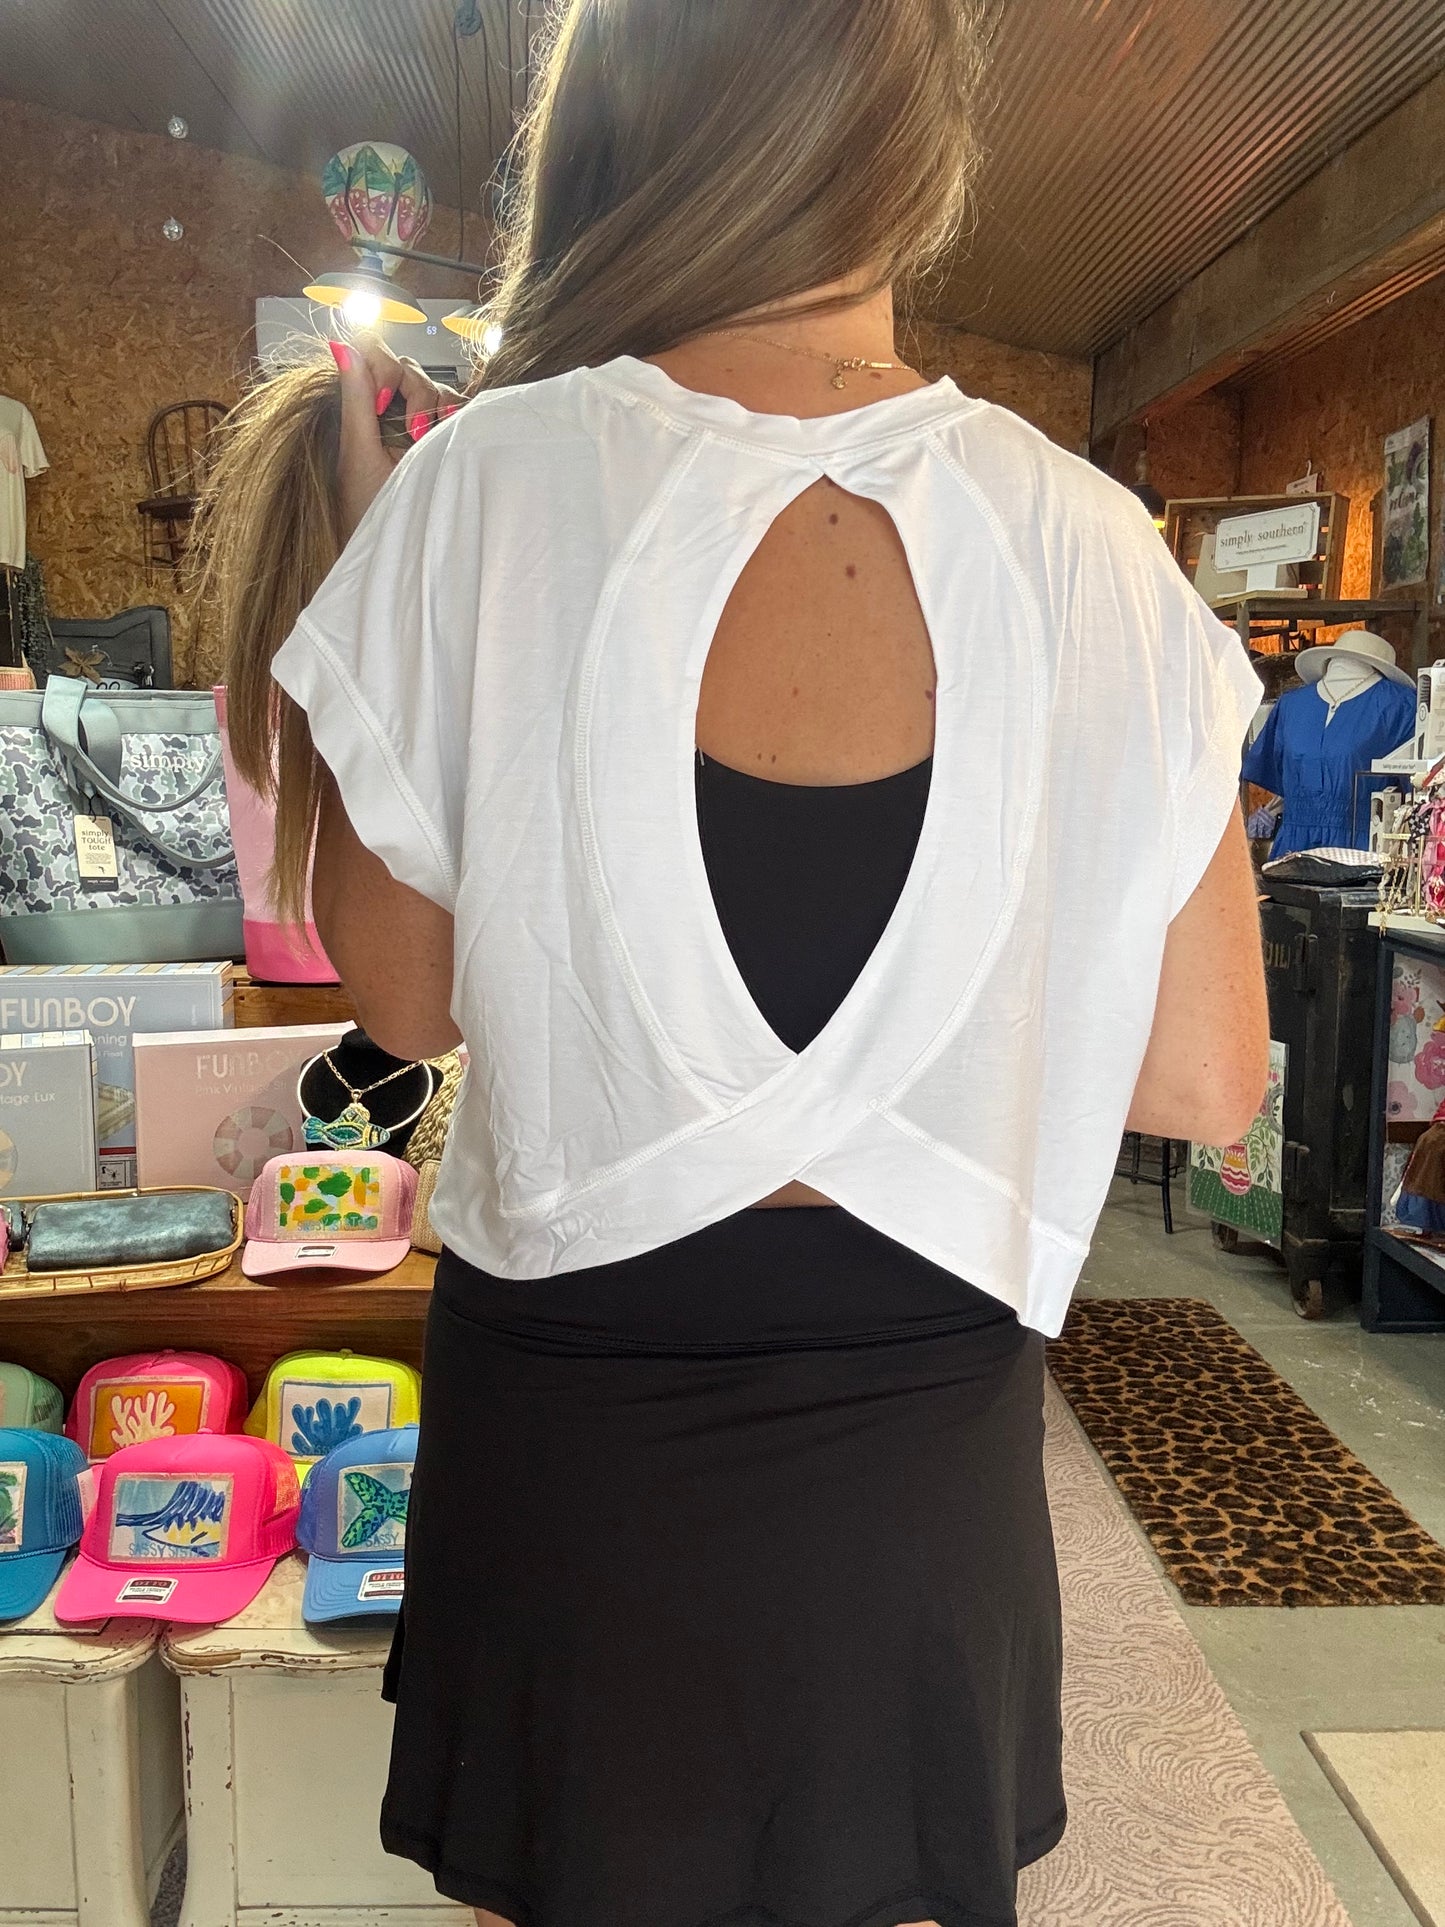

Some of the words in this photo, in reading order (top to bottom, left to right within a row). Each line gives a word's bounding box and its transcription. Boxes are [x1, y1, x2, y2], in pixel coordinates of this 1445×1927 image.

[427, 325, 437, 335] 69
[1220, 530, 1253, 548] simply
[1258, 523, 1304, 541] southern
[130, 752, 205, 773] simply
[81, 829, 108, 838] simply
[81, 836, 111, 845] TOUGH
[0, 996, 136, 1029] FUNBOY
[364, 1531, 400, 1548] SASSY
[129, 1542, 166, 1558] SASSY
